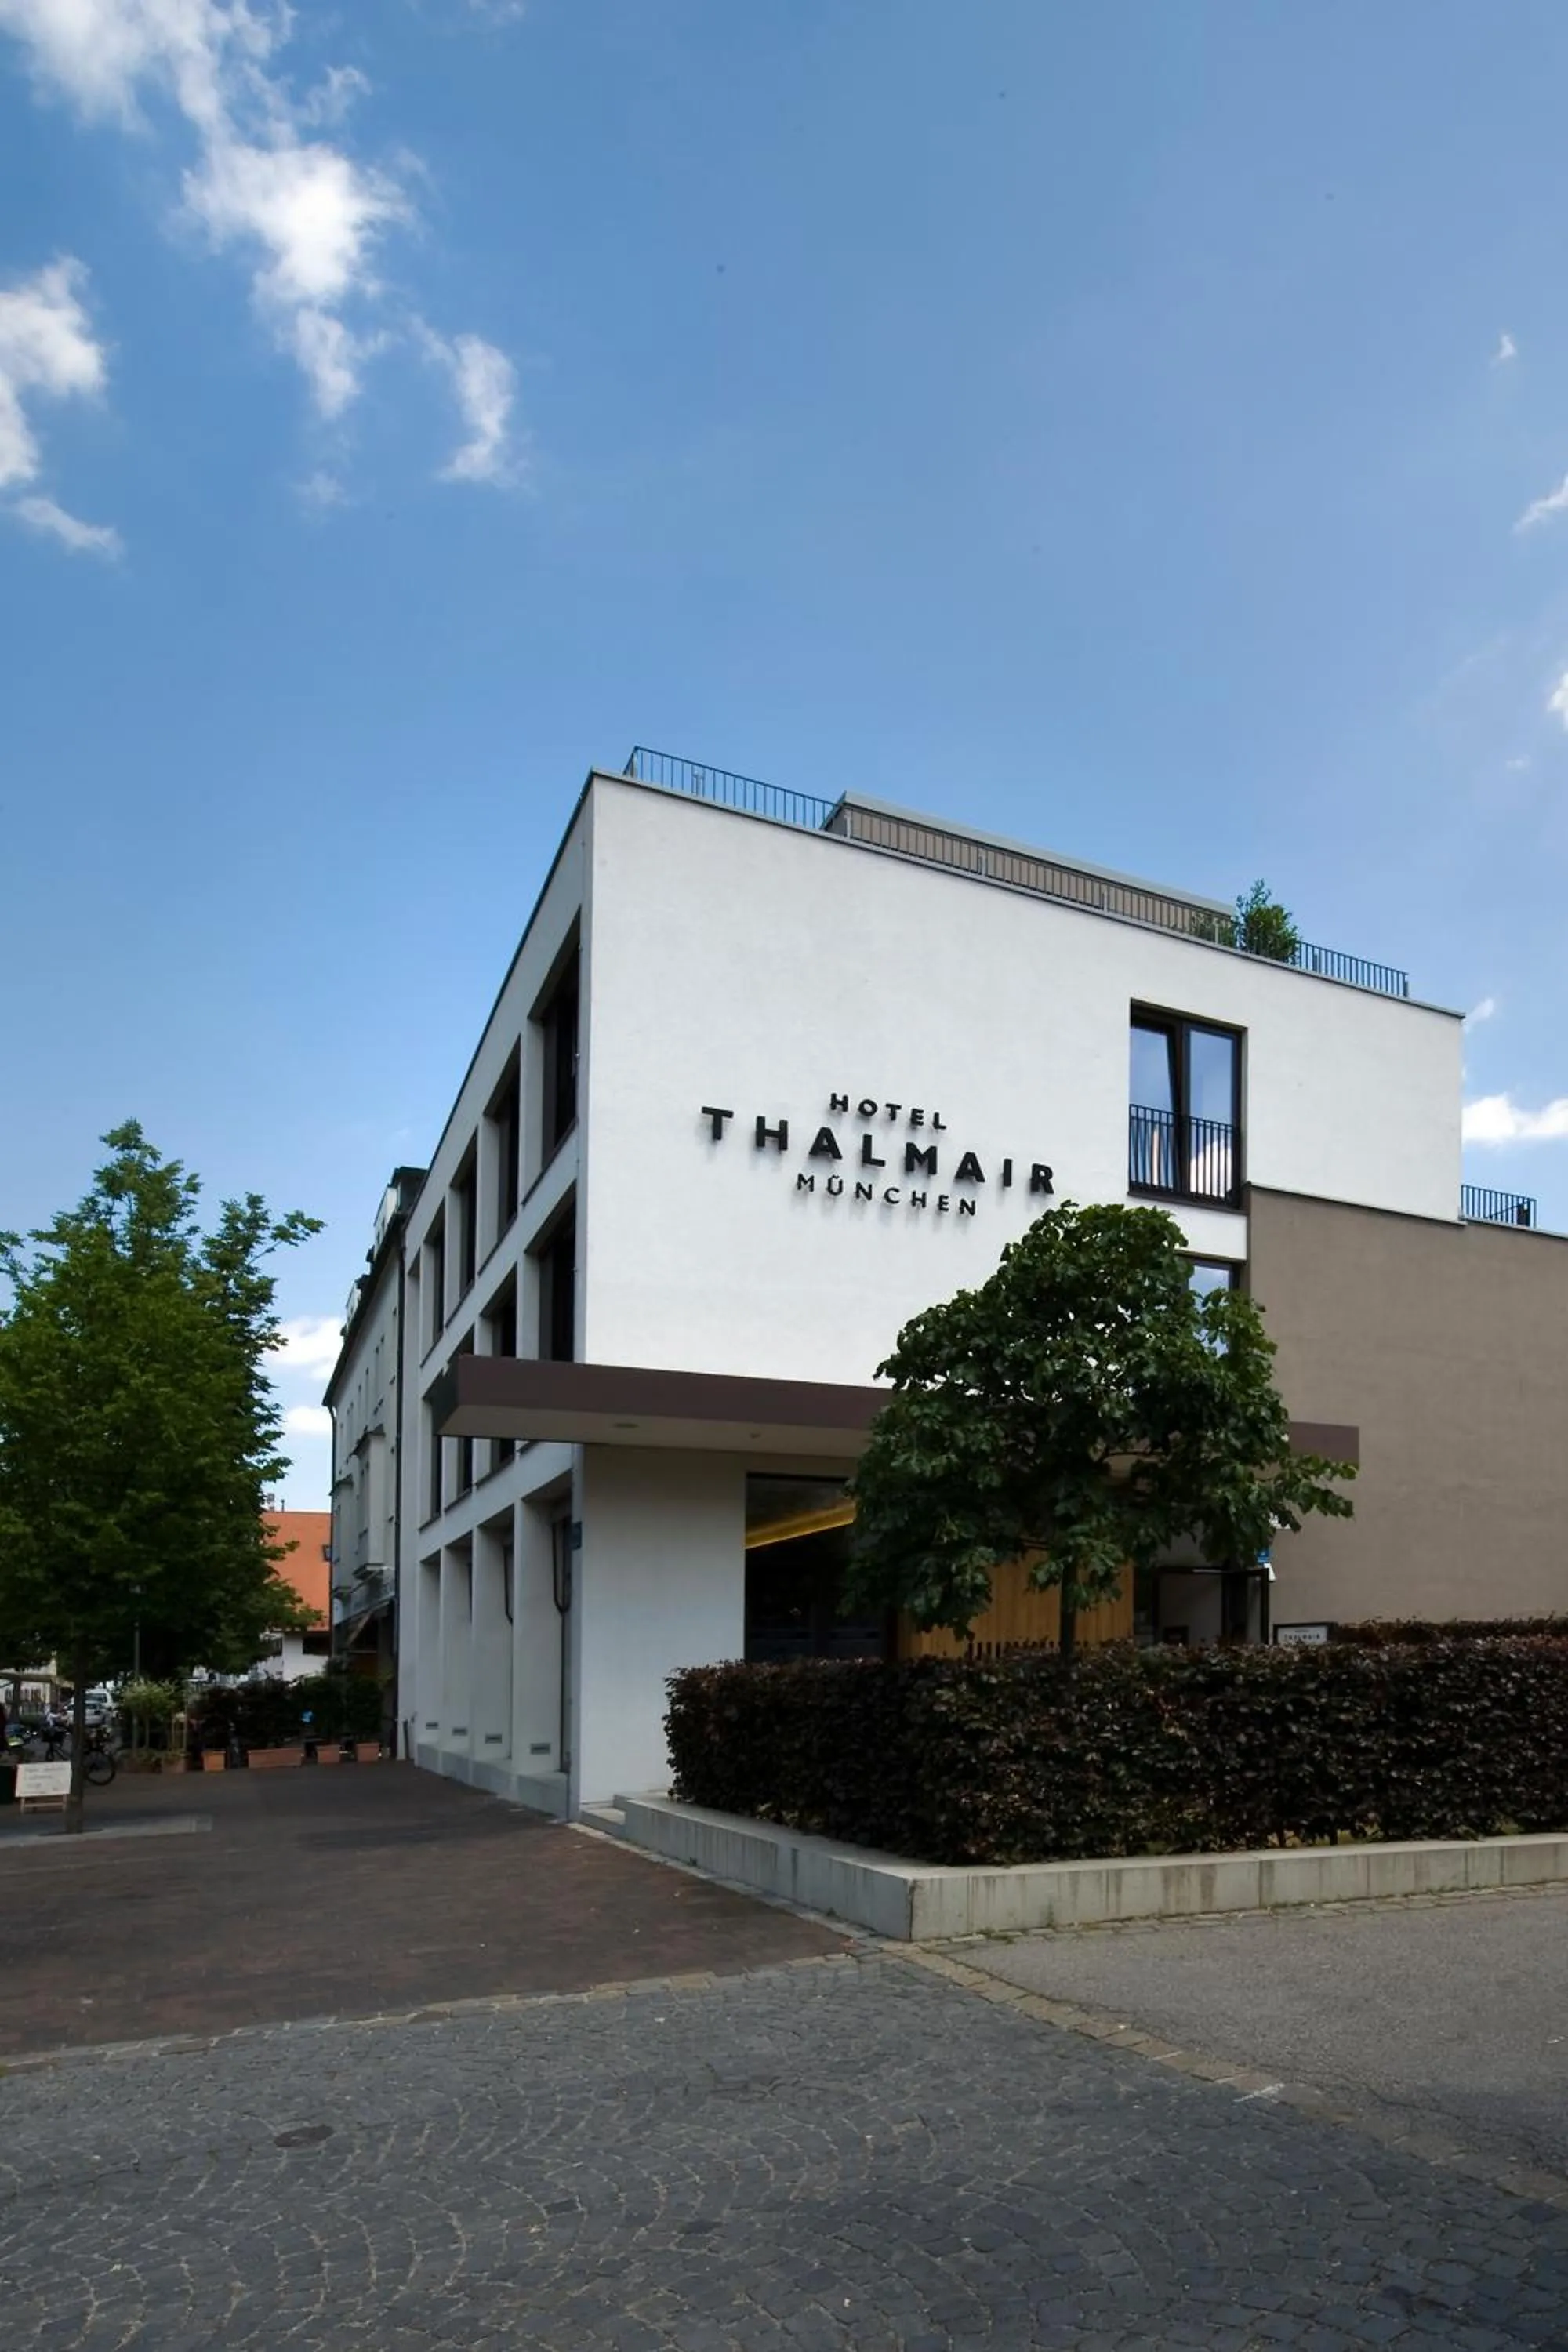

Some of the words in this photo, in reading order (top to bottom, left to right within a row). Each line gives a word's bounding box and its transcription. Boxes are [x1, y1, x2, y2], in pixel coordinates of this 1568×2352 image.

[829, 1092, 947, 1131] HOTEL
[701, 1106, 1054, 1197] THALMAIR
[796, 1173, 976, 1217] MÜNCHEN
